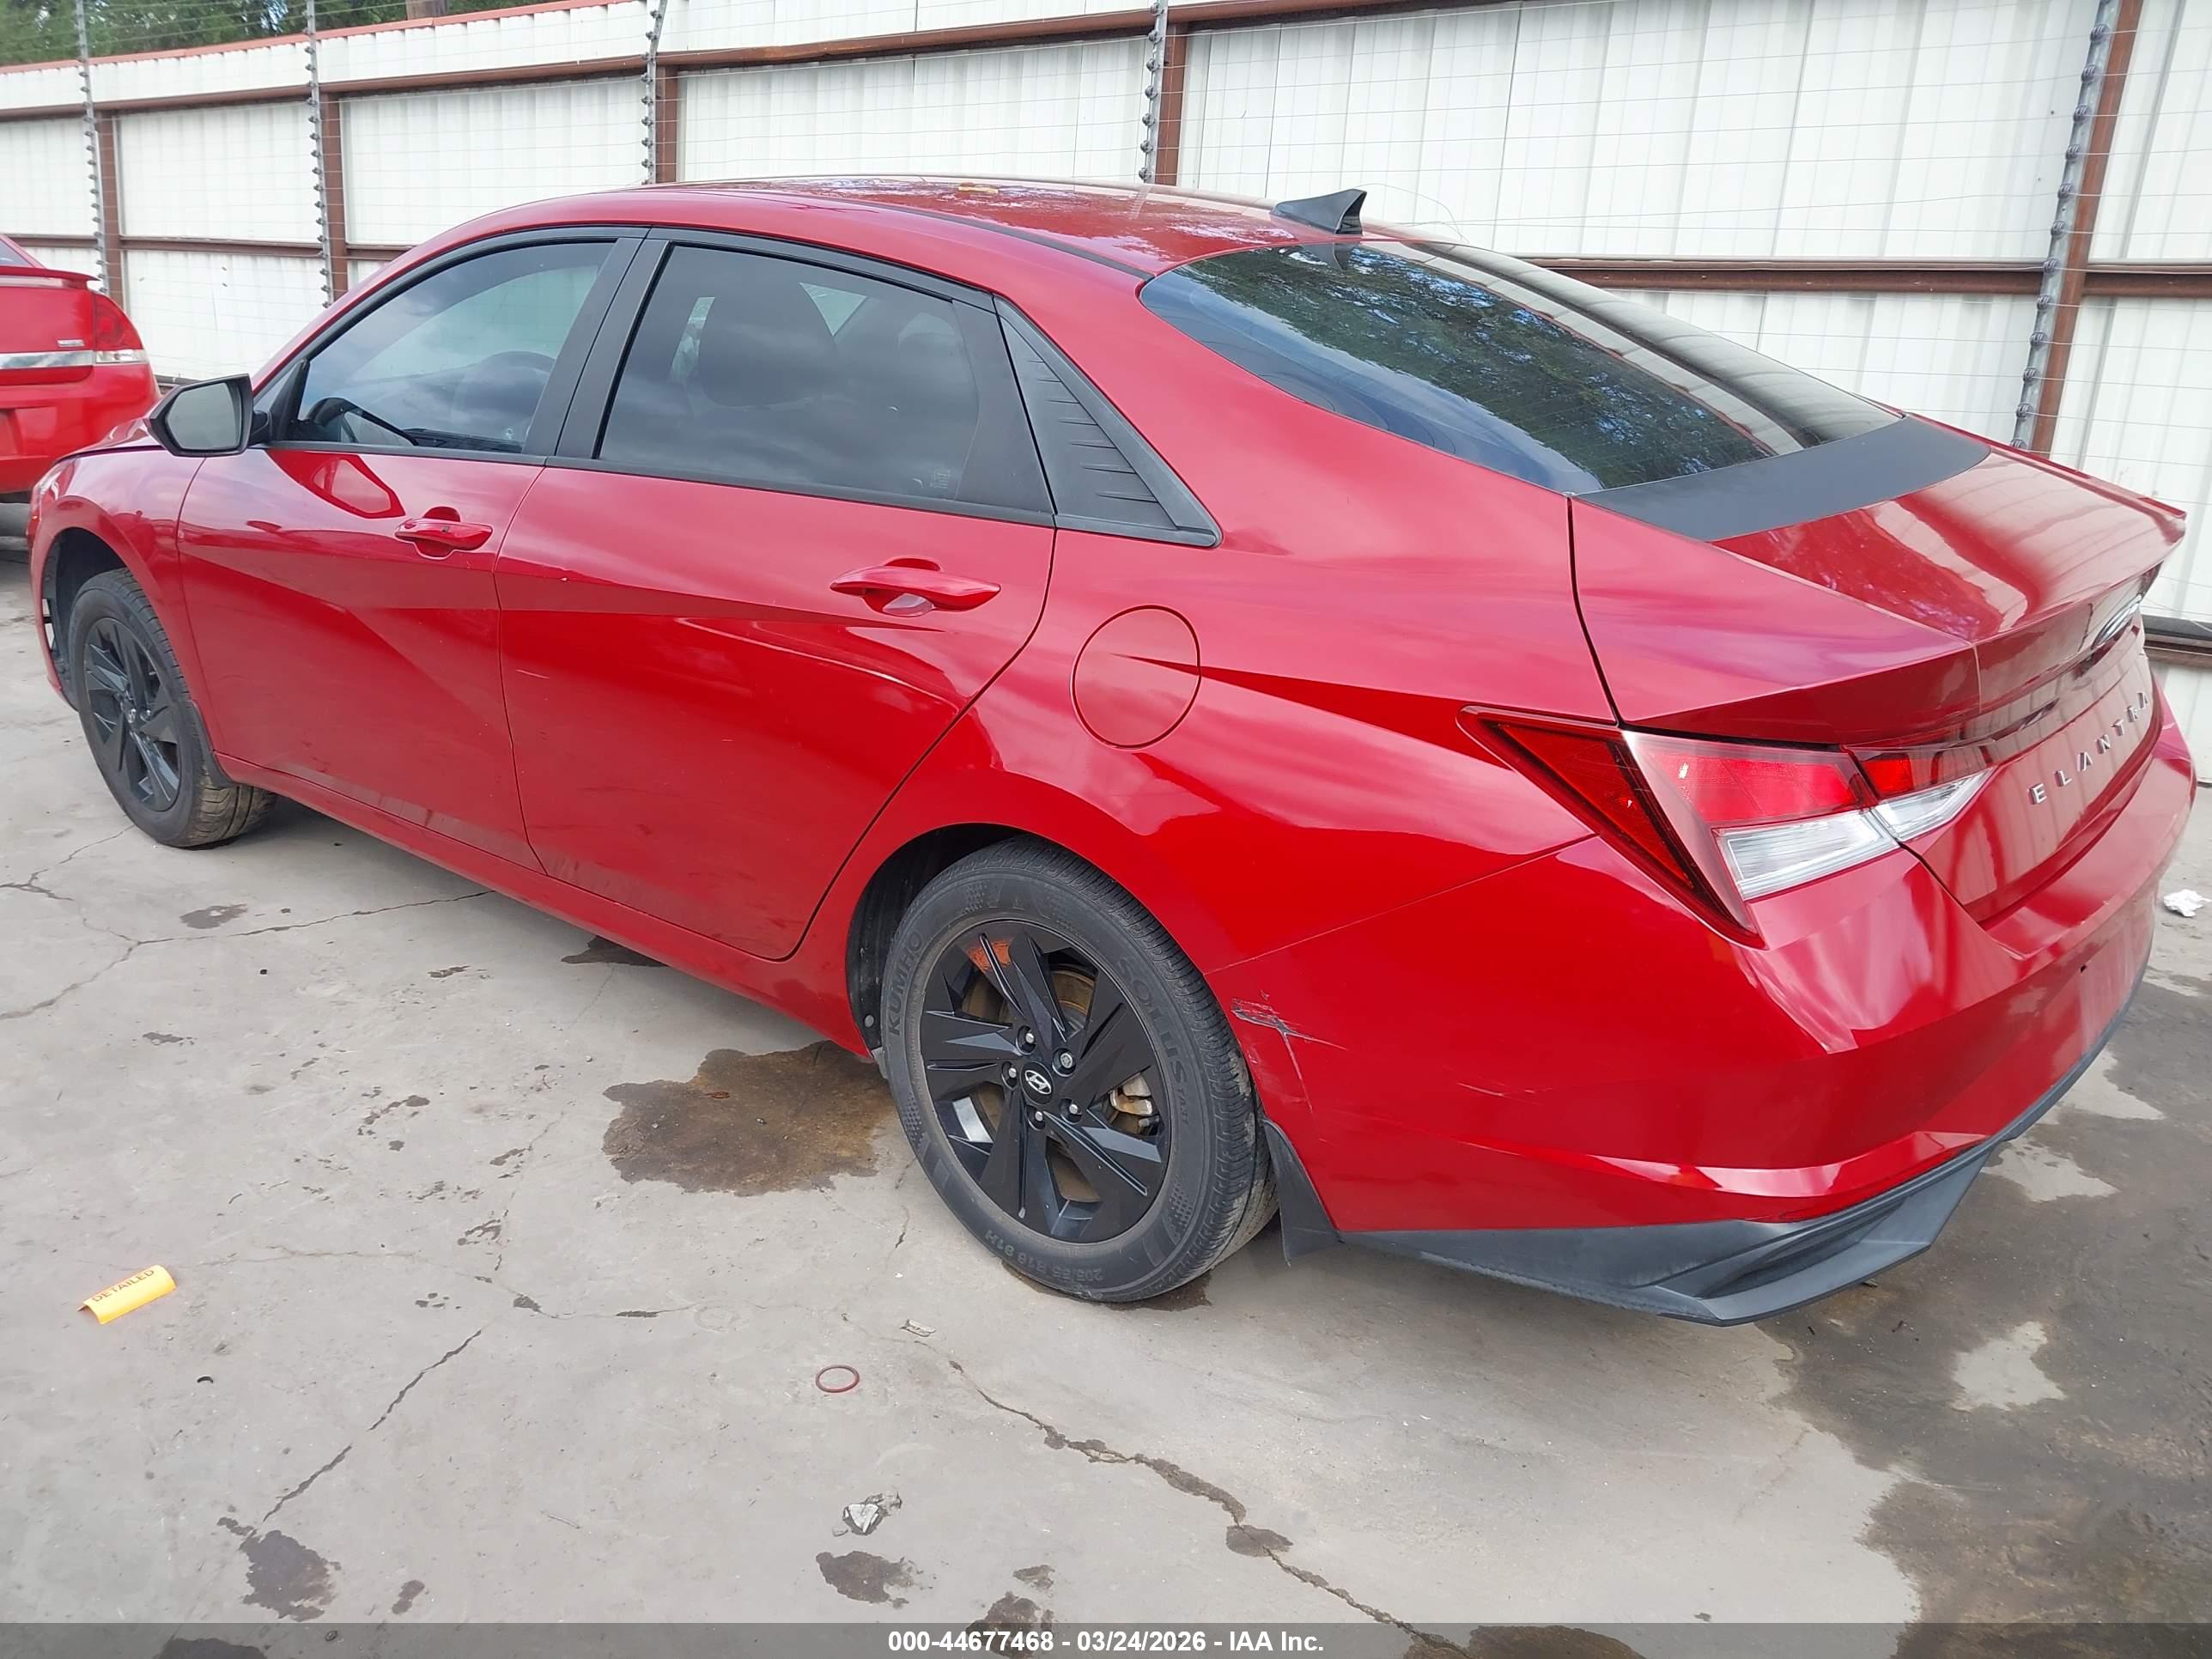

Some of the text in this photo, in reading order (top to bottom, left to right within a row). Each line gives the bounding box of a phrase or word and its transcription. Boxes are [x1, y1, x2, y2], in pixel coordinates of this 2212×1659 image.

[2027, 692, 2148, 805] ELANTRA
[888, 930, 924, 1036] KUMHO
[91, 1269, 155, 1302] DETAILED
